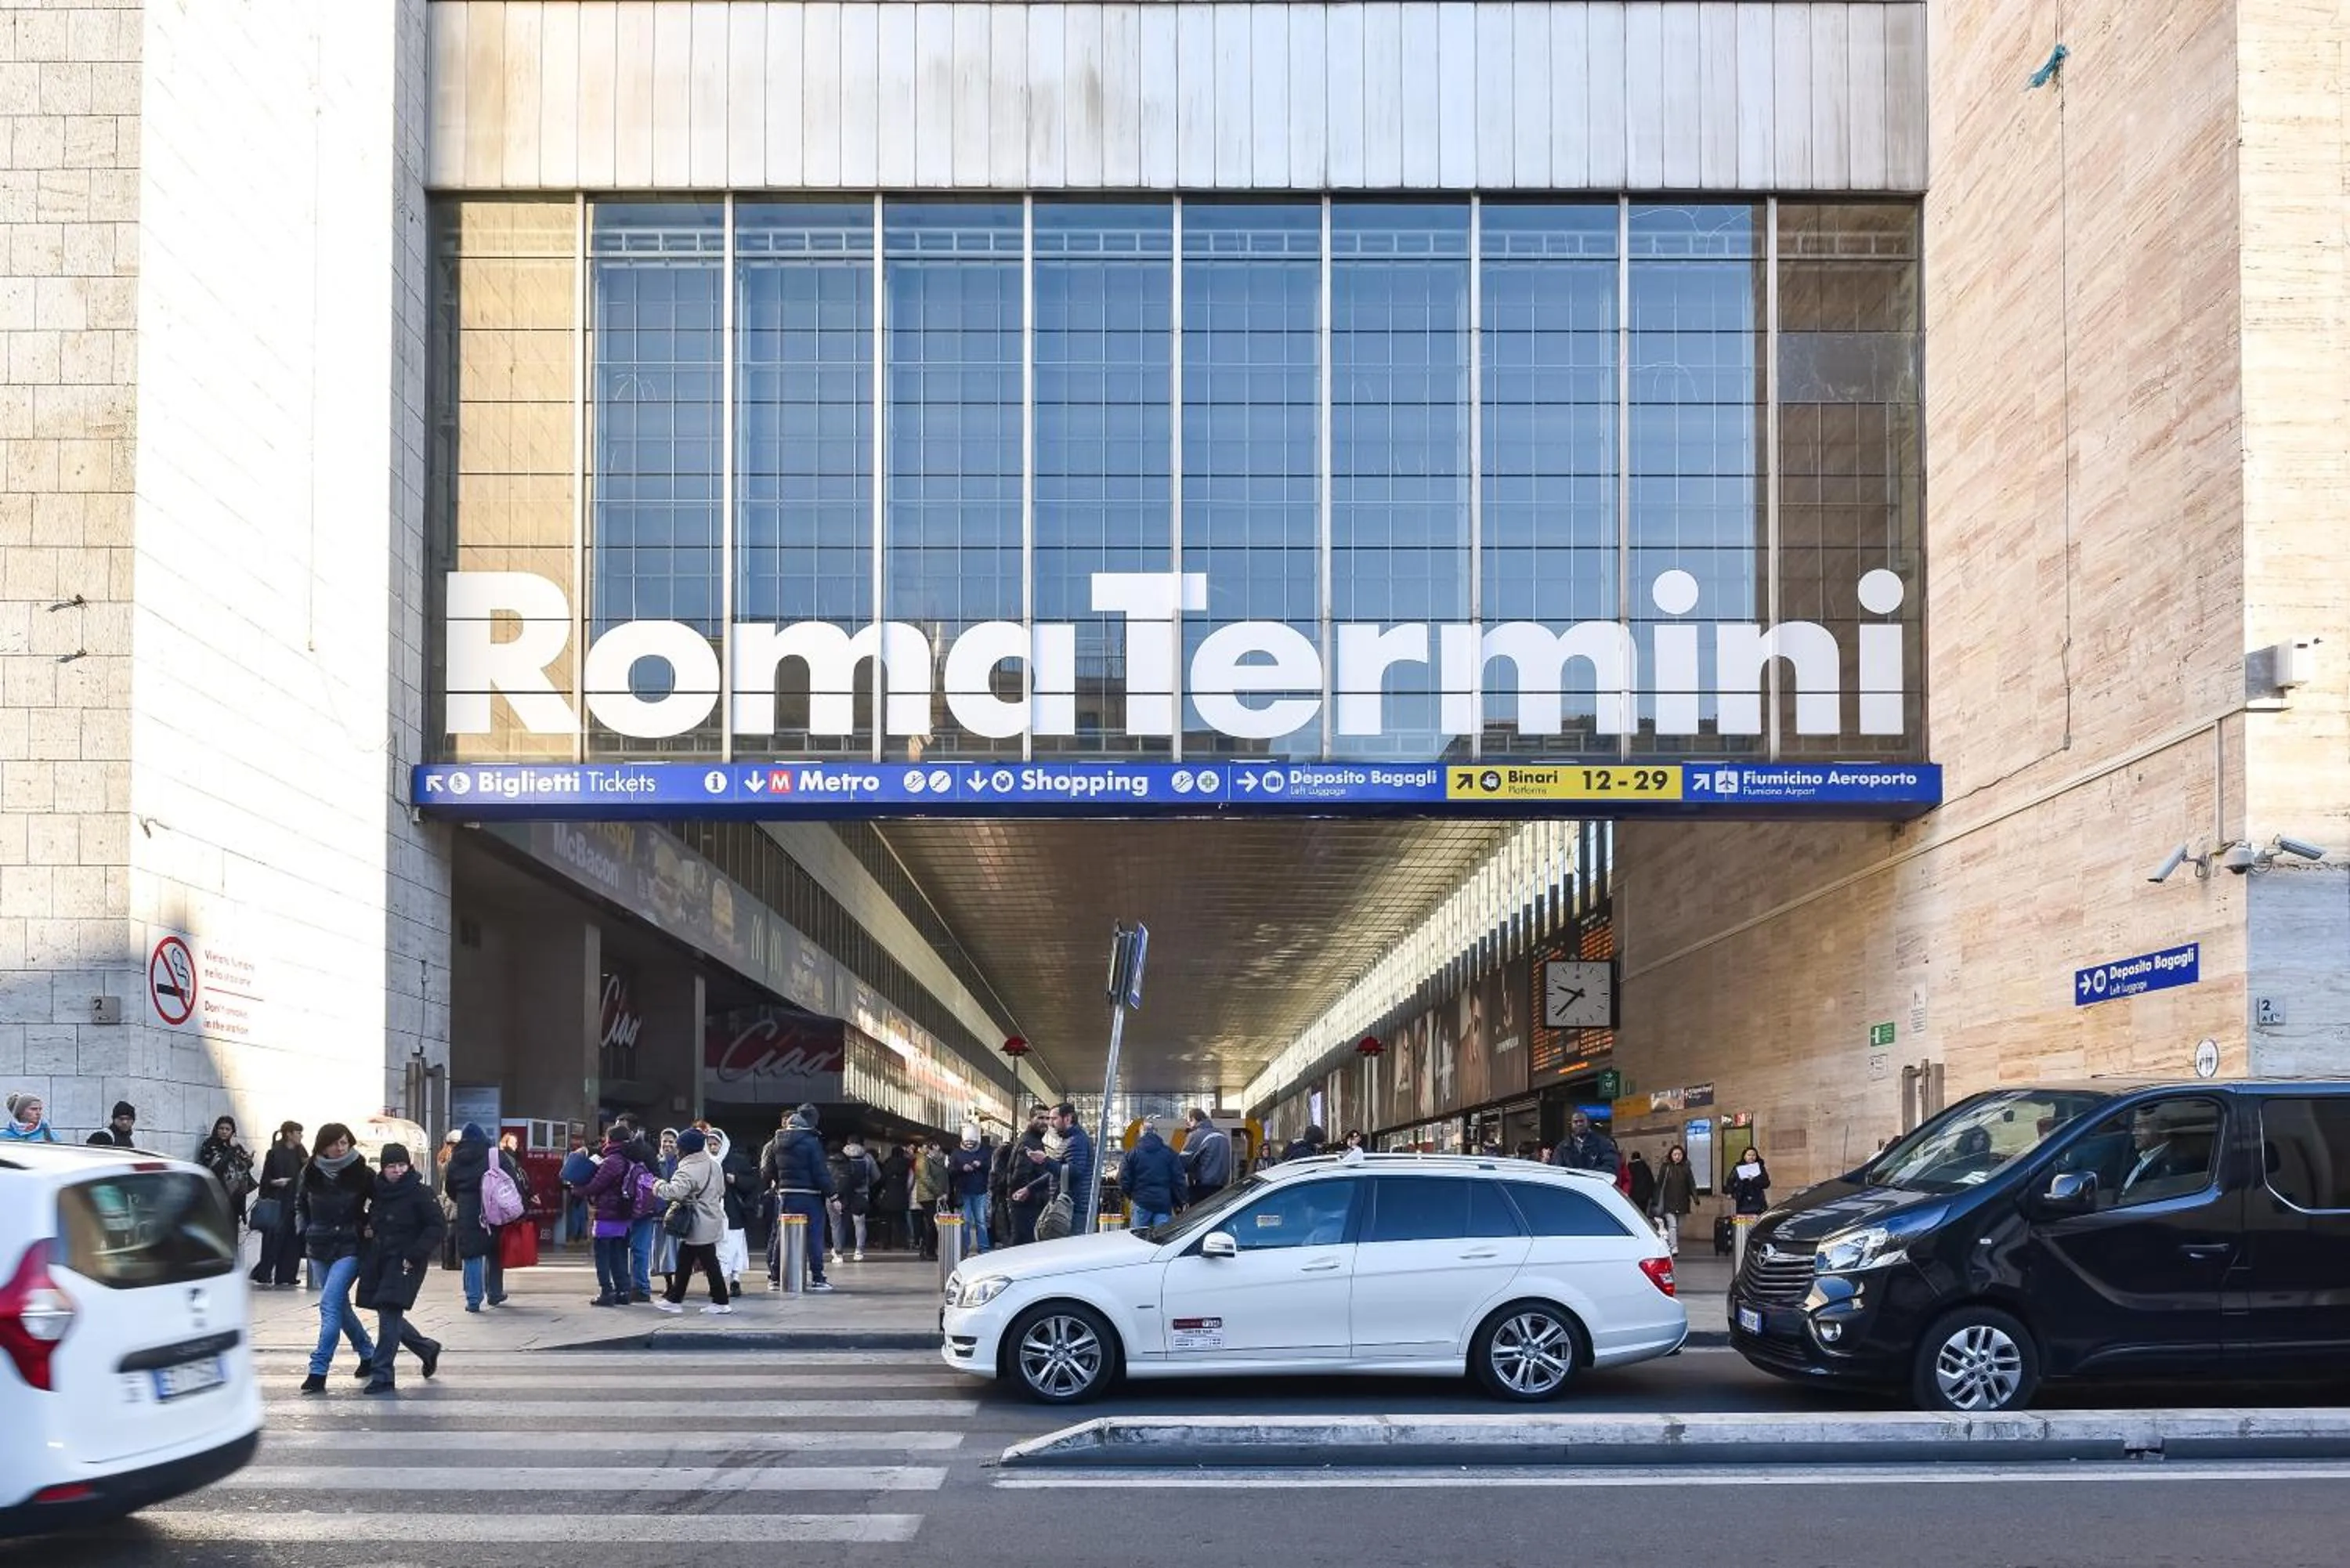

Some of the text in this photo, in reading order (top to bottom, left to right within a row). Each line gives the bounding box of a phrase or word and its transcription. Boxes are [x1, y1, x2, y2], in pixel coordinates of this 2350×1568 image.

[478, 770, 656, 797] Biglietti Tickets
[798, 771, 880, 791] Metro
[1021, 768, 1148, 796] Shopping
[1290, 769, 1437, 787] Deposito Bagagli
[1508, 770, 1558, 784] Binari
[1743, 770, 1917, 788] Fiumicino Aeroporto
[2110, 948, 2194, 980] Deposito Bagagli
[2261, 999, 2271, 1011] 2
[717, 1020, 844, 1082] Ciao
